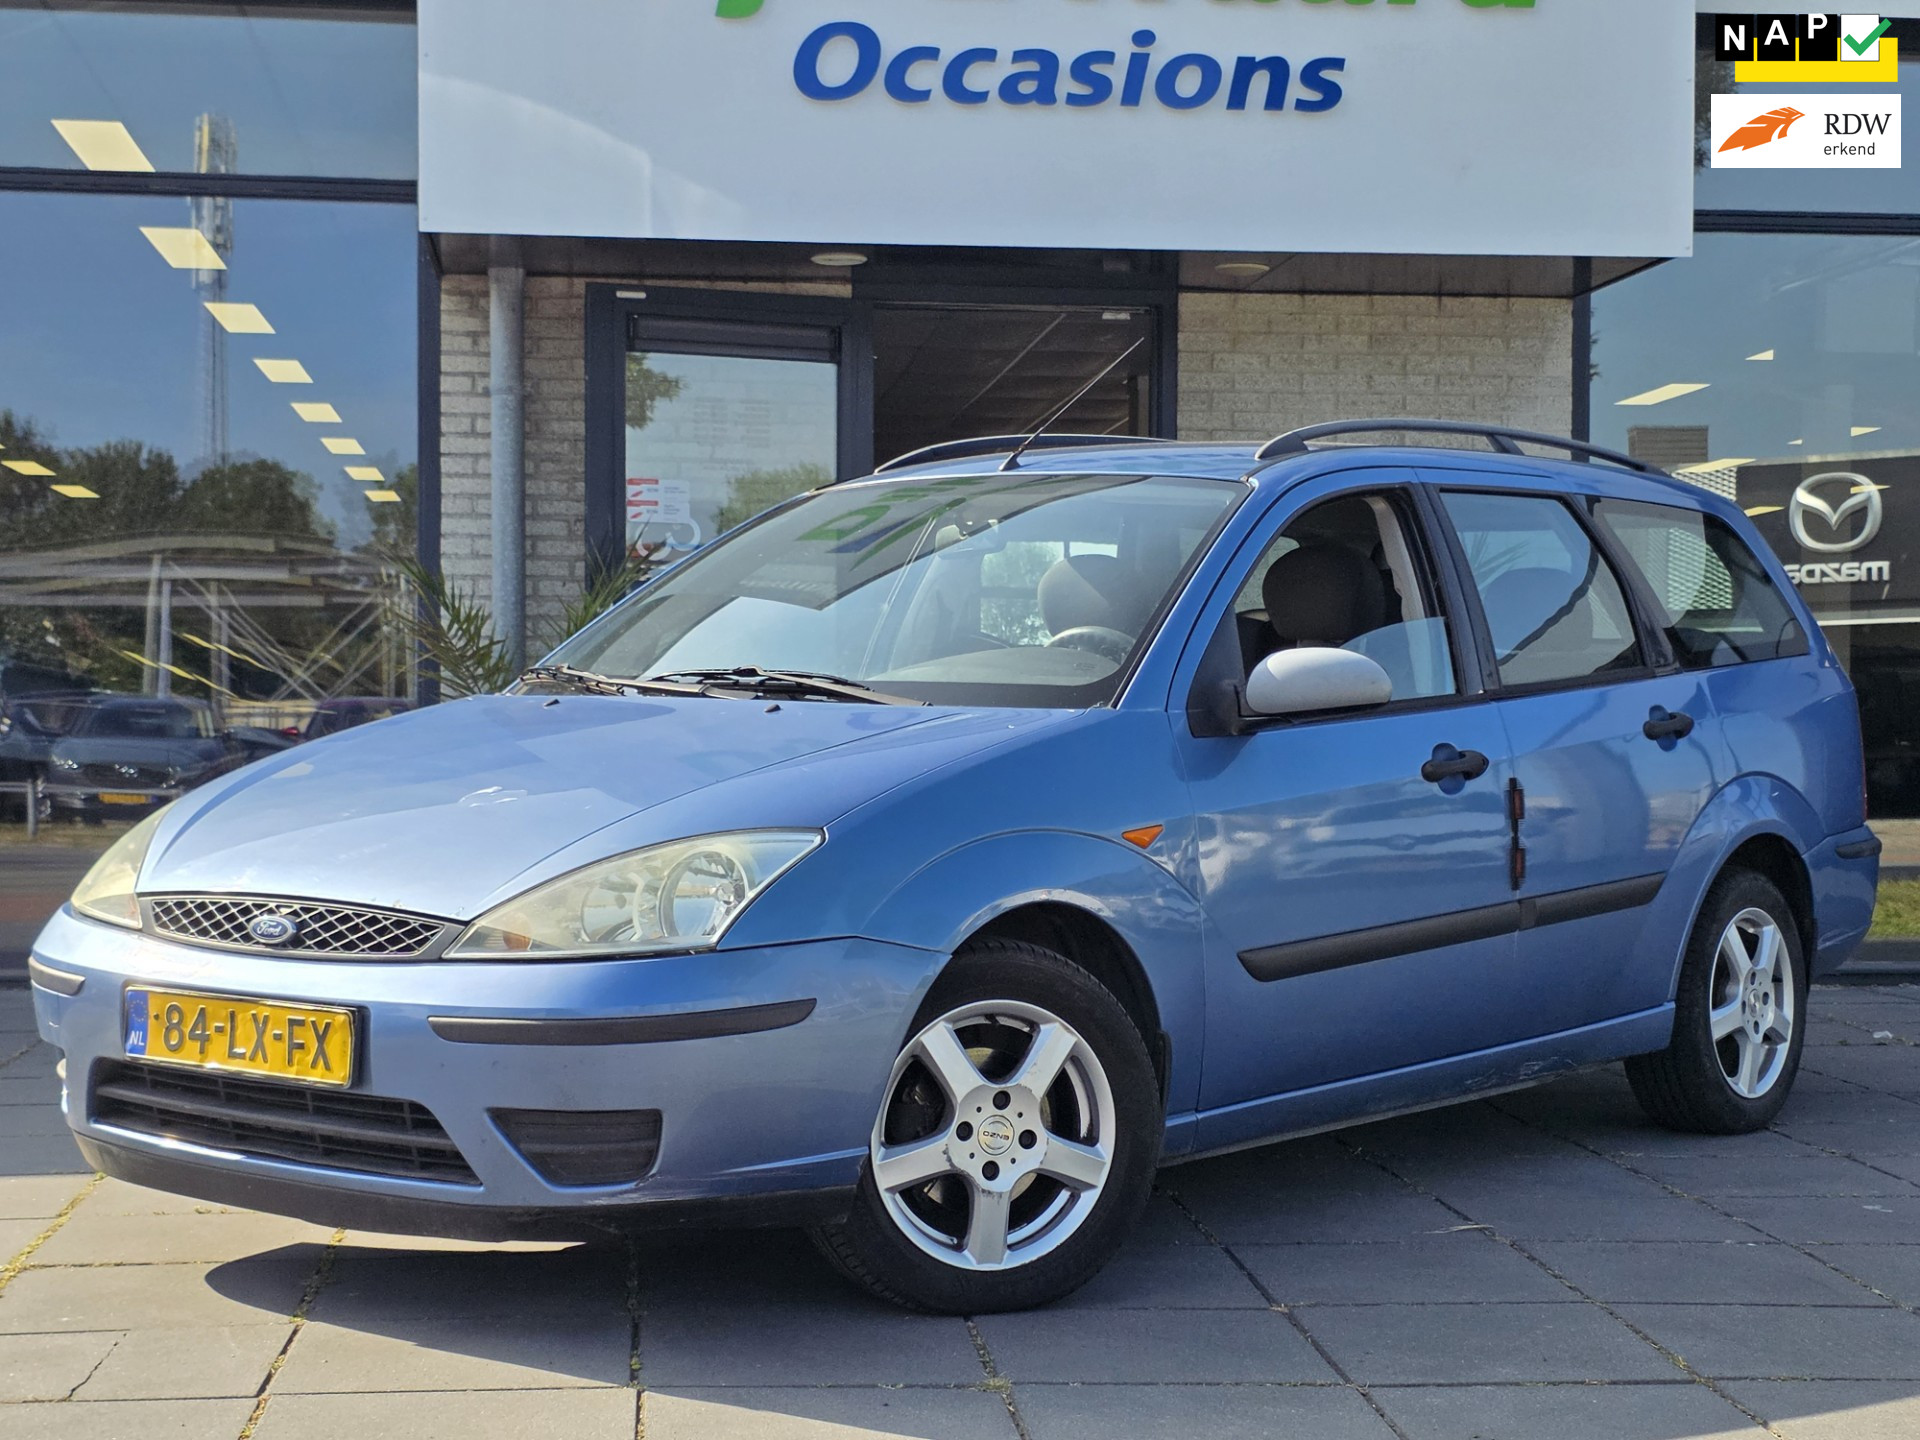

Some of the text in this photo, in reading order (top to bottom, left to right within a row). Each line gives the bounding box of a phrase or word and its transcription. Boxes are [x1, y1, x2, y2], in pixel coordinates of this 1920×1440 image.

[793, 21, 1345, 112] Occasions
[256, 920, 282, 936] Ford
[127, 1030, 145, 1047] NL
[162, 1001, 334, 1072] 84-LX-FX
